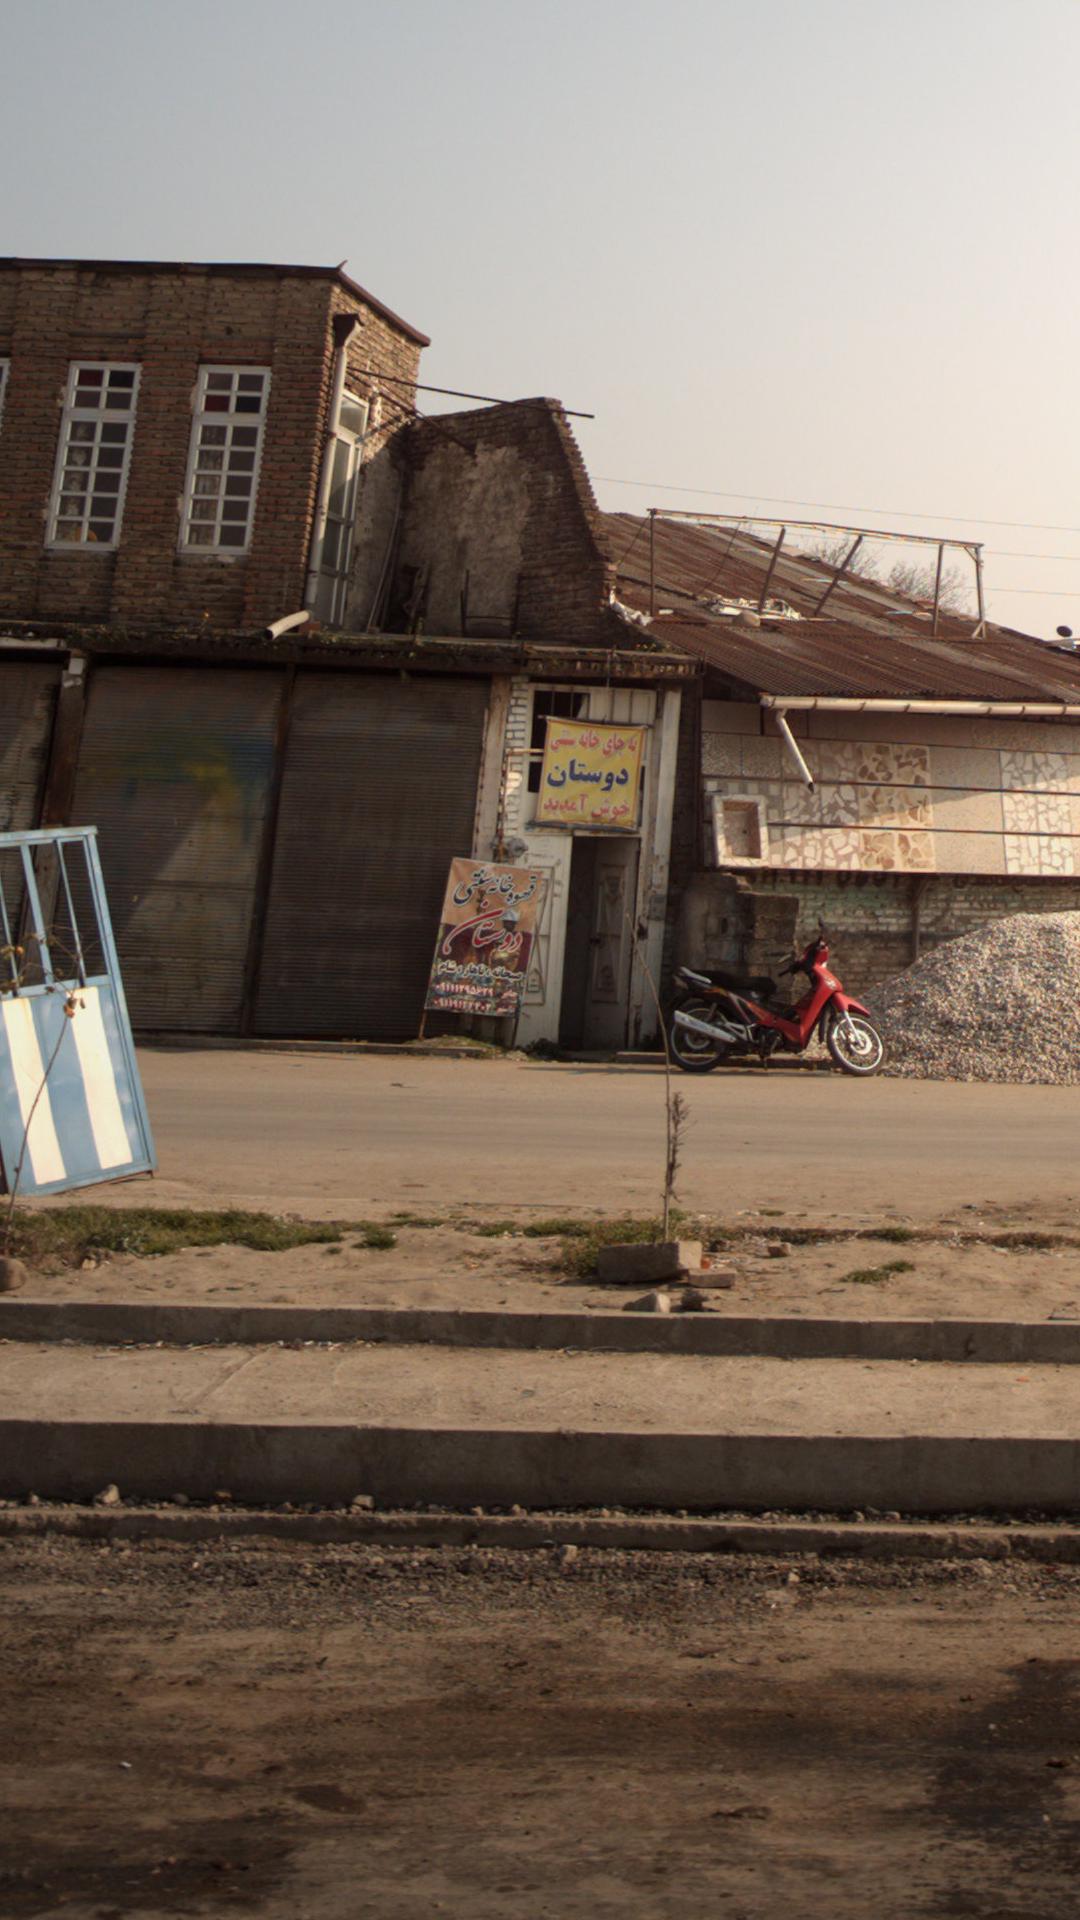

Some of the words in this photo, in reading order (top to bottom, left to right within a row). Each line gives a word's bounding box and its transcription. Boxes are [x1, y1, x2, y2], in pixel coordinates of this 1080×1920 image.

[550, 729, 577, 752] سنتی
[579, 729, 601, 750] خانه
[602, 733, 625, 757] چای
[546, 758, 629, 791] دوستان
[543, 793, 589, 816] آمدید
[591, 798, 630, 824] خوش
[453, 867, 494, 906] سنتی
[486, 873, 515, 893] خانه
[505, 874, 537, 904] قهوه
[442, 899, 523, 955] دوستان
